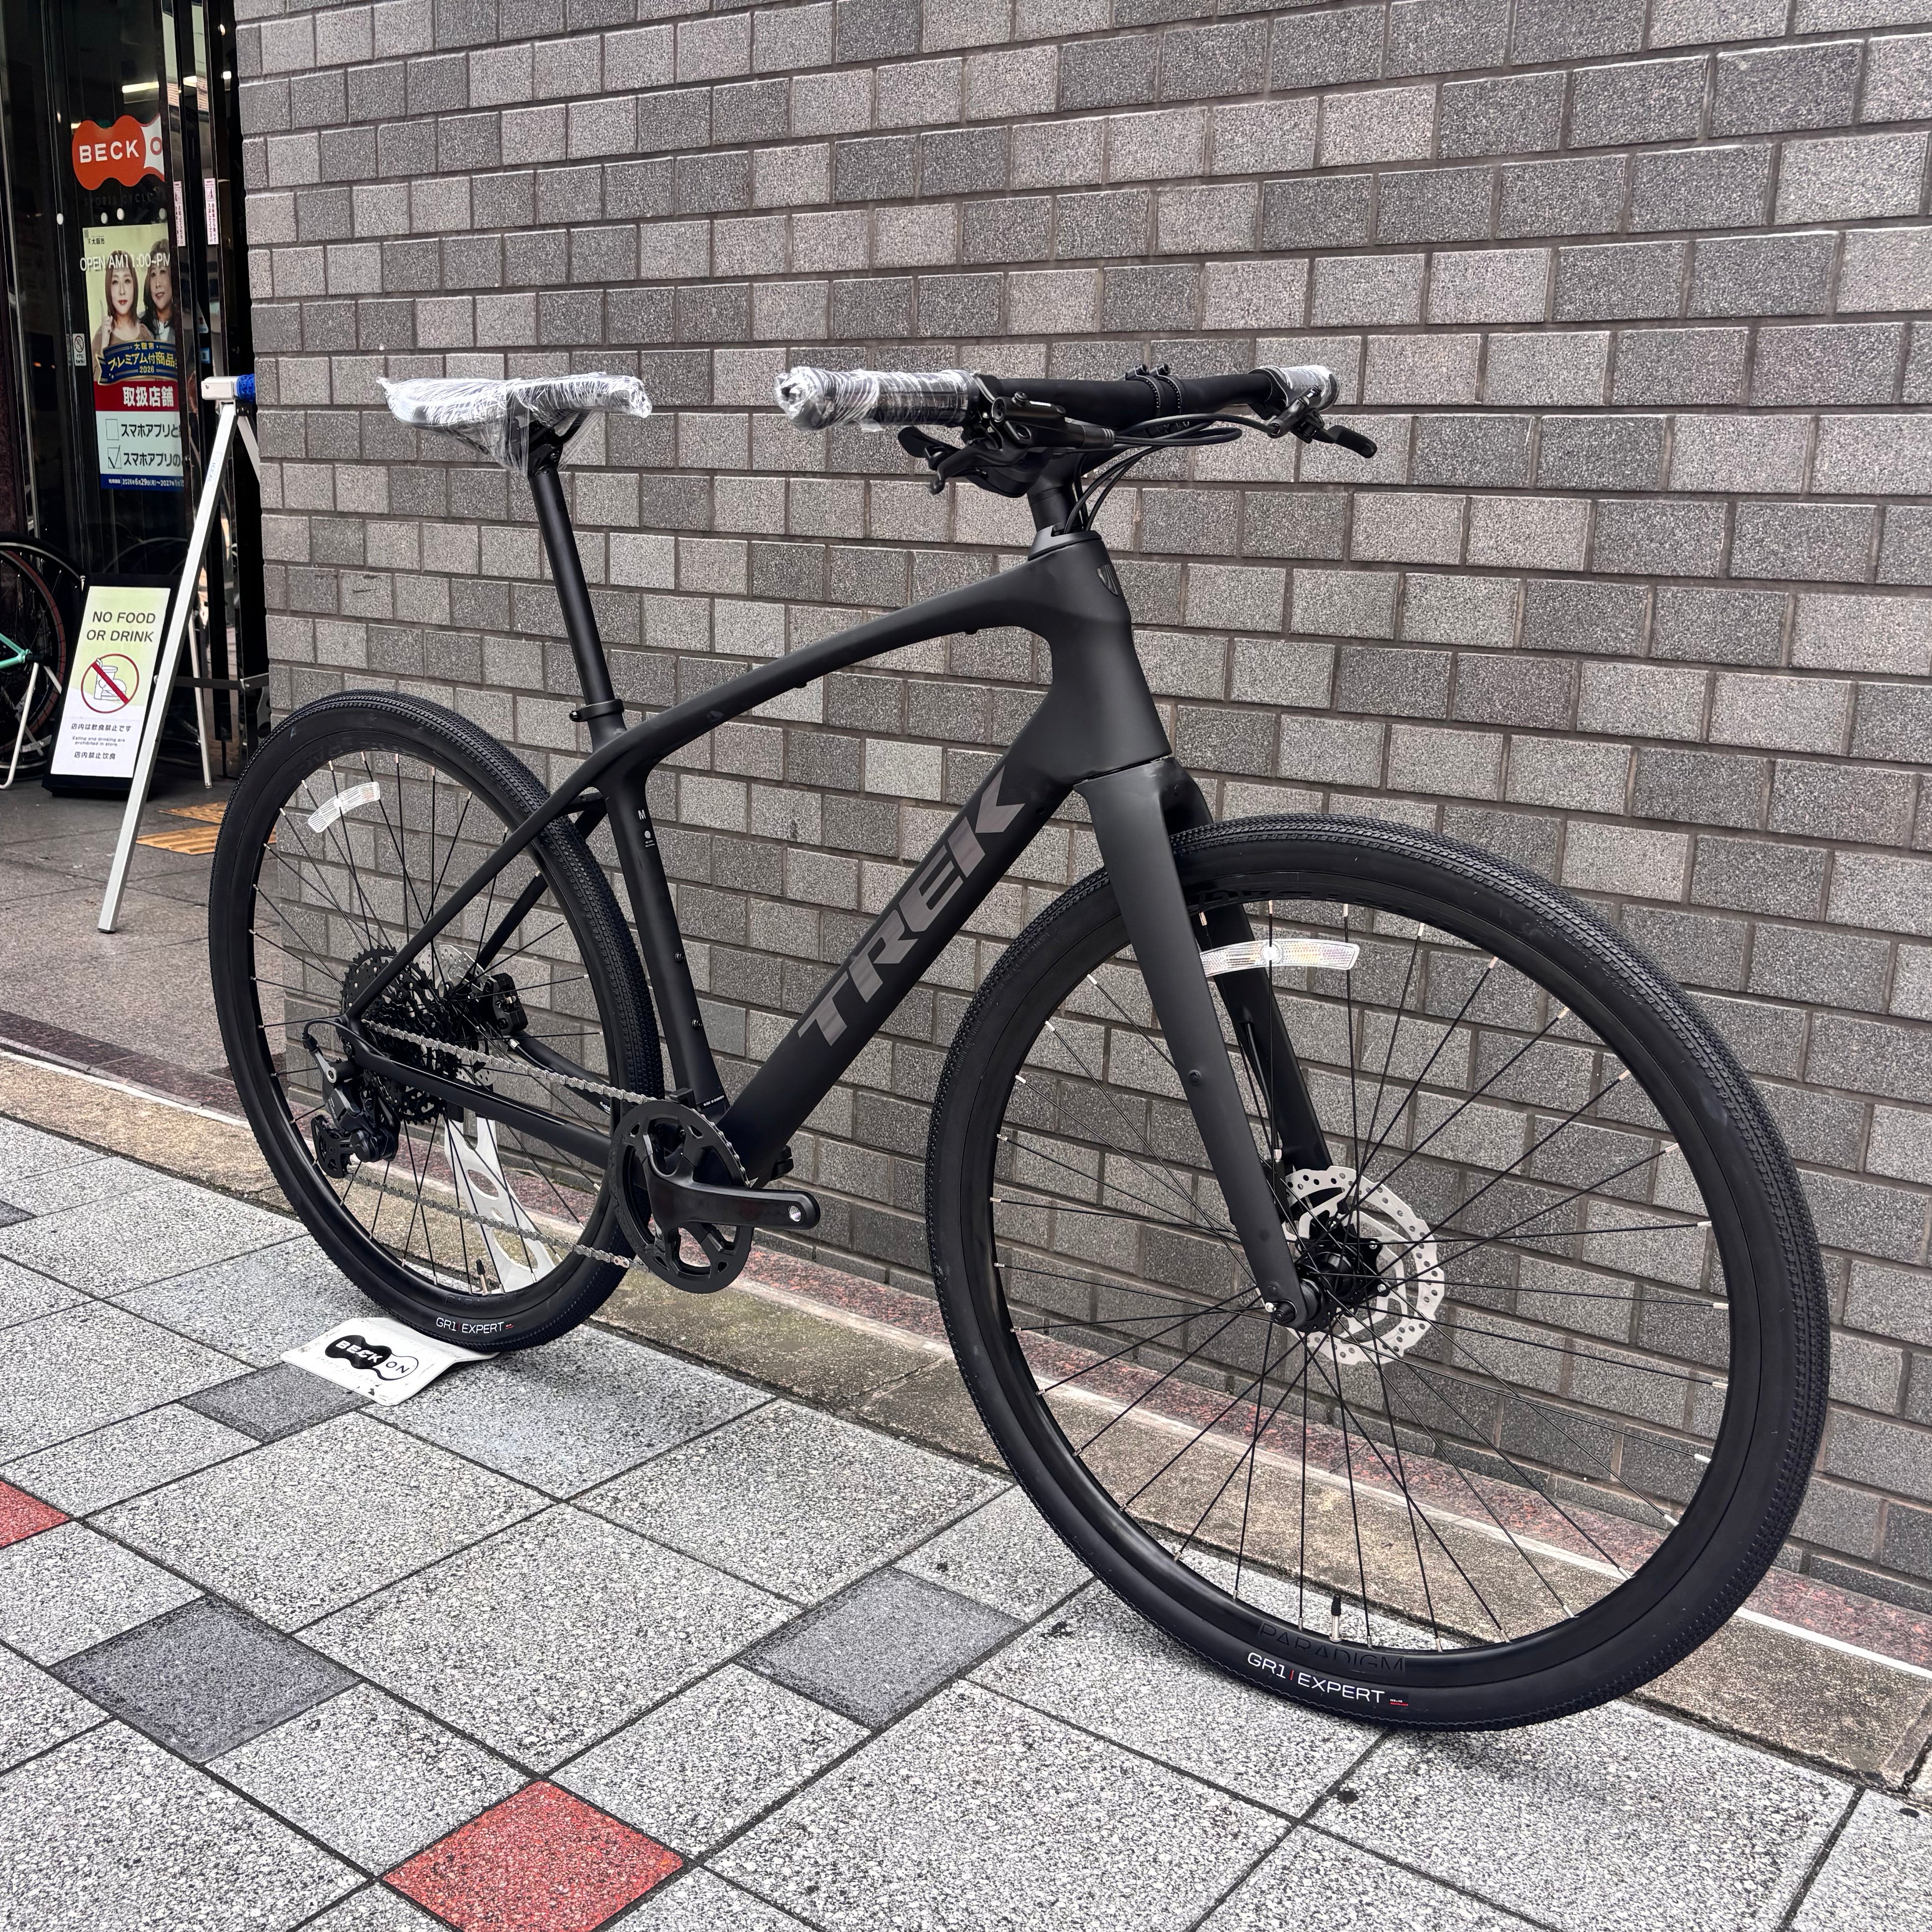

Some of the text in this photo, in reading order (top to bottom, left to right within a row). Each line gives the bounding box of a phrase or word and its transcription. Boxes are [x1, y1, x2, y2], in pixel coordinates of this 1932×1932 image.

[79, 139, 139, 163] BECK
[80, 255, 106, 271] OPEN
[122, 386, 174, 407] 取扱店舗
[121, 423, 181, 437] スマホアプリと
[123, 452, 181, 467] スマホアプリの
[92, 611, 156, 623] NO FOOD
[87, 629, 154, 642] OR DRINK
[638, 809, 646, 820] M
[798, 765, 1025, 1046] TREK
[436, 1317, 457, 1330] GR1
[461, 1321, 504, 1334] EXPERT
[336, 1339, 384, 1363] BECK
[386, 1361, 411, 1374] ON
[1260, 1622, 1403, 1671] PARADIGM
[1247, 1652, 1385, 1703] GR1 EXPERT
